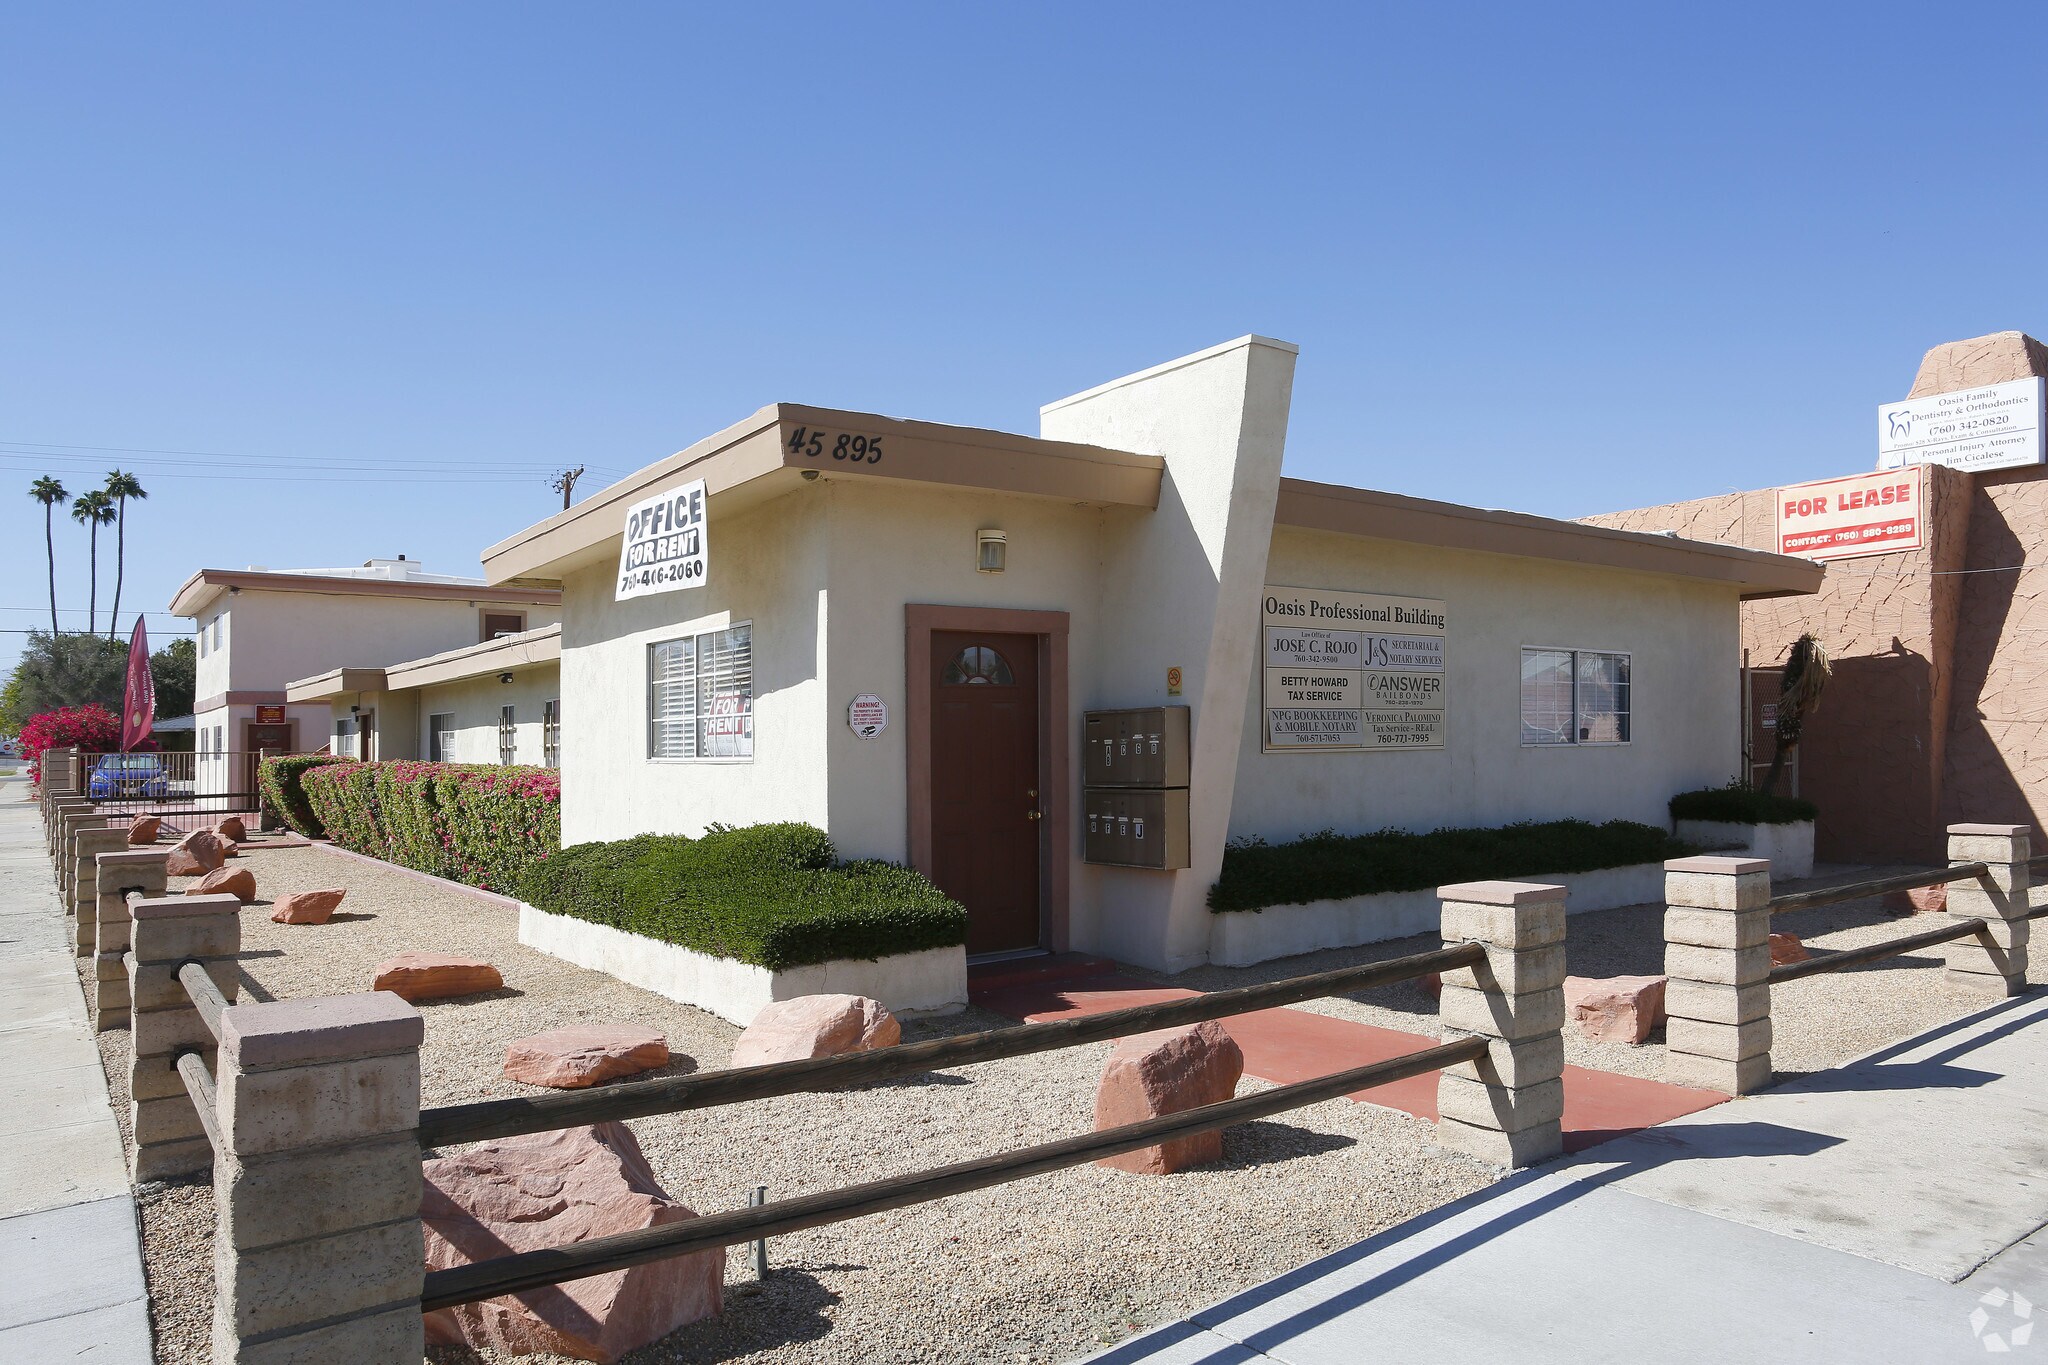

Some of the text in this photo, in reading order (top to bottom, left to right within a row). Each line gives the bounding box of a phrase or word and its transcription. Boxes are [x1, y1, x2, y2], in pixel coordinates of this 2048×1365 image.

[1939, 390, 1998, 406] Oasis Family
[1911, 406, 1953, 422] Dentistry
[1955, 406, 1964, 414] &
[1966, 396, 2029, 412] Orthodontics
[1929, 423, 1956, 436] (760)
[1959, 415, 2009, 430] 342-0820
[1976, 424, 2017, 436] Consultation
[788, 427, 882, 464] 45 895
[1922, 435, 2027, 457] Personal Injury Attorney
[1946, 456, 1962, 466] Jim
[1965, 450, 2004, 462] Cicalese
[1784, 484, 1910, 519] FOR LEASE
[629, 490, 701, 543] OFFICE
[1785, 524, 1912, 547] CONTACT: (760) 880-8289
[628, 529, 697, 570] FOR RENT
[621, 560, 702, 592] 760-406-2060
[1266, 596, 1445, 629] Oasis Professional Building
[1274, 639, 1357, 654] JOSE C. ROJO
[1365, 637, 1388, 666] J&S
[1392, 640, 1434, 651] SECRETARIAL
[1294, 655, 1338, 663] 760-342-9500
[1389, 654, 1442, 665] NOTARY SERVICES
[1281, 676, 1348, 687] BETTY HOWARD
[1379, 676, 1440, 692] ANSWER
[1288, 691, 1342, 701] TAX SERVICE
[1376, 692, 1432, 700] BAILBONDS
[716, 698, 738, 714] FOR
[1272, 710, 1358, 721] NPG BOOKKEEPING
[1366, 712, 1441, 722] VERONICA PALOMINO
[709, 717, 741, 733] RENT
[1275, 722, 1357, 732] & MOBILE NOTARY
[1372, 725, 1385, 733] Tax
[1386, 724, 1409, 733] Service
[1296, 734, 1340, 743] 760-571-7053
[1377, 734, 1429, 743] 760-771-7995
[1137, 825, 1142, 837] J
